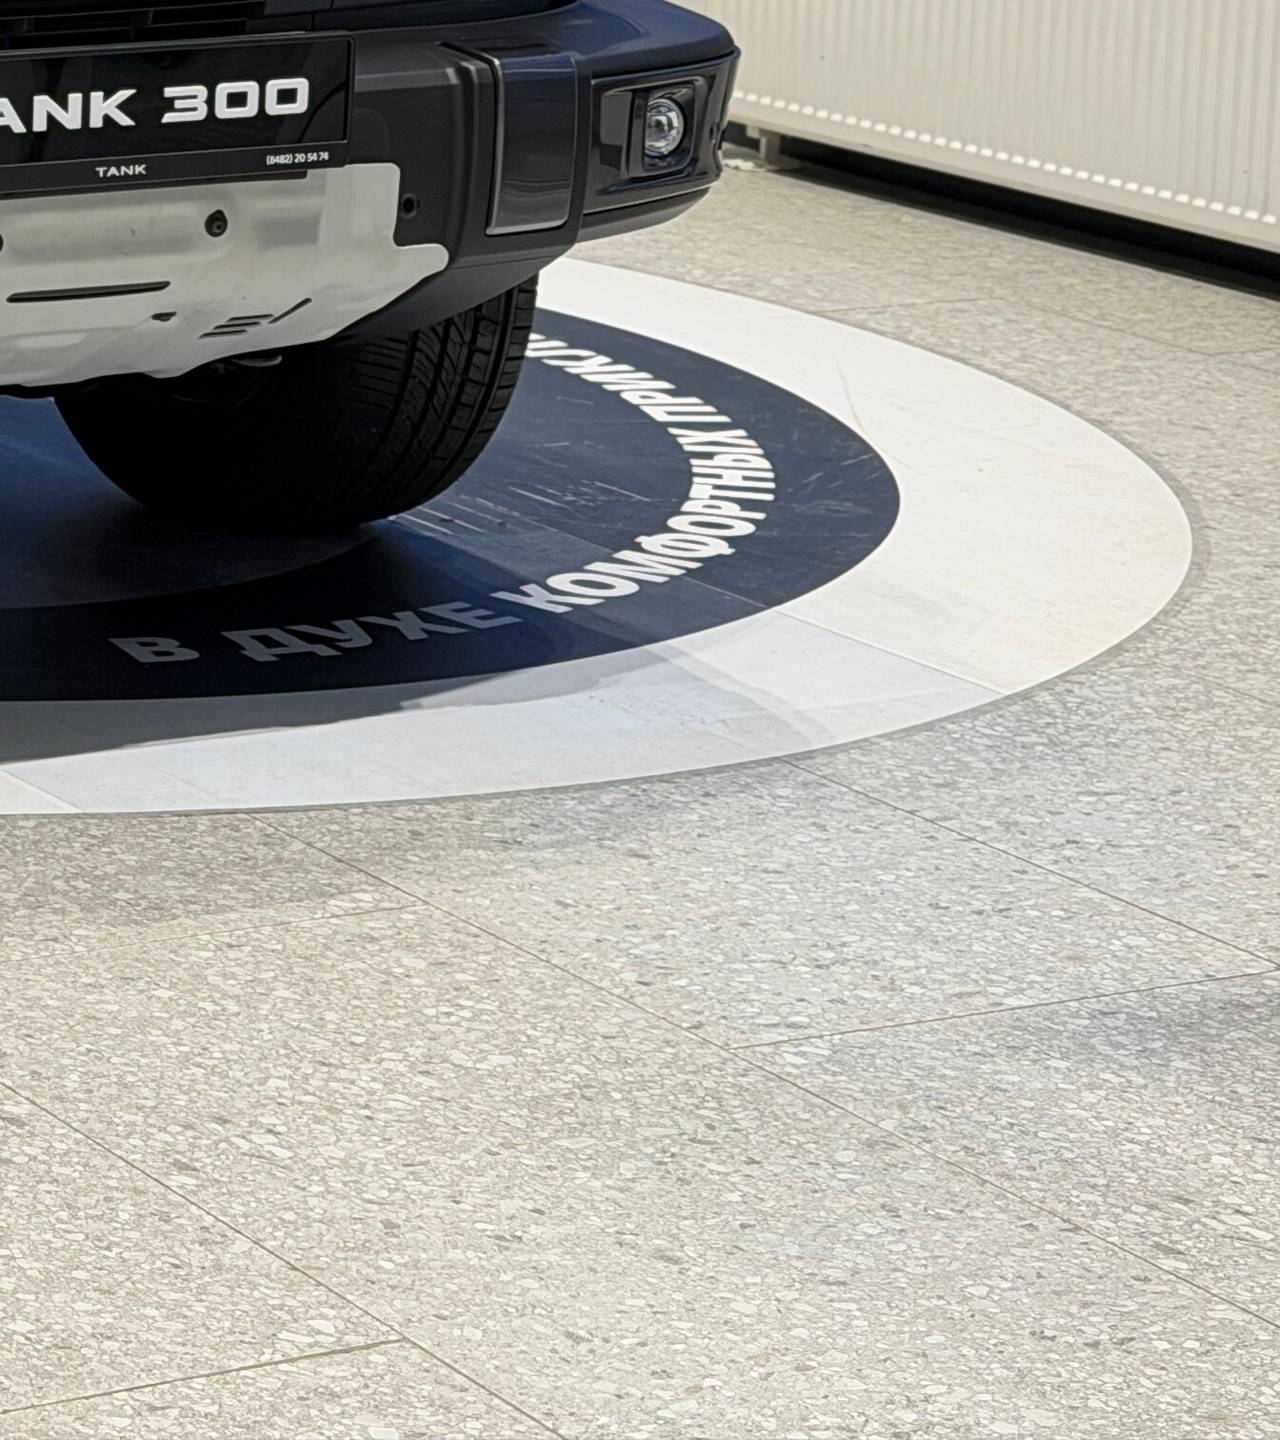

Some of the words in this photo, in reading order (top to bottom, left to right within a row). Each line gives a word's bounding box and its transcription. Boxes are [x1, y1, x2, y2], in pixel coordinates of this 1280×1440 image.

[159, 77, 311, 125] 300
[95, 164, 148, 179] TANK
[266, 153, 294, 166] (8482)
[295, 153, 306, 164] 20
[108, 636, 201, 663] В
[220, 601, 524, 662] ДУХЕ
[490, 428, 777, 614] КОМФОРТНЫХ
